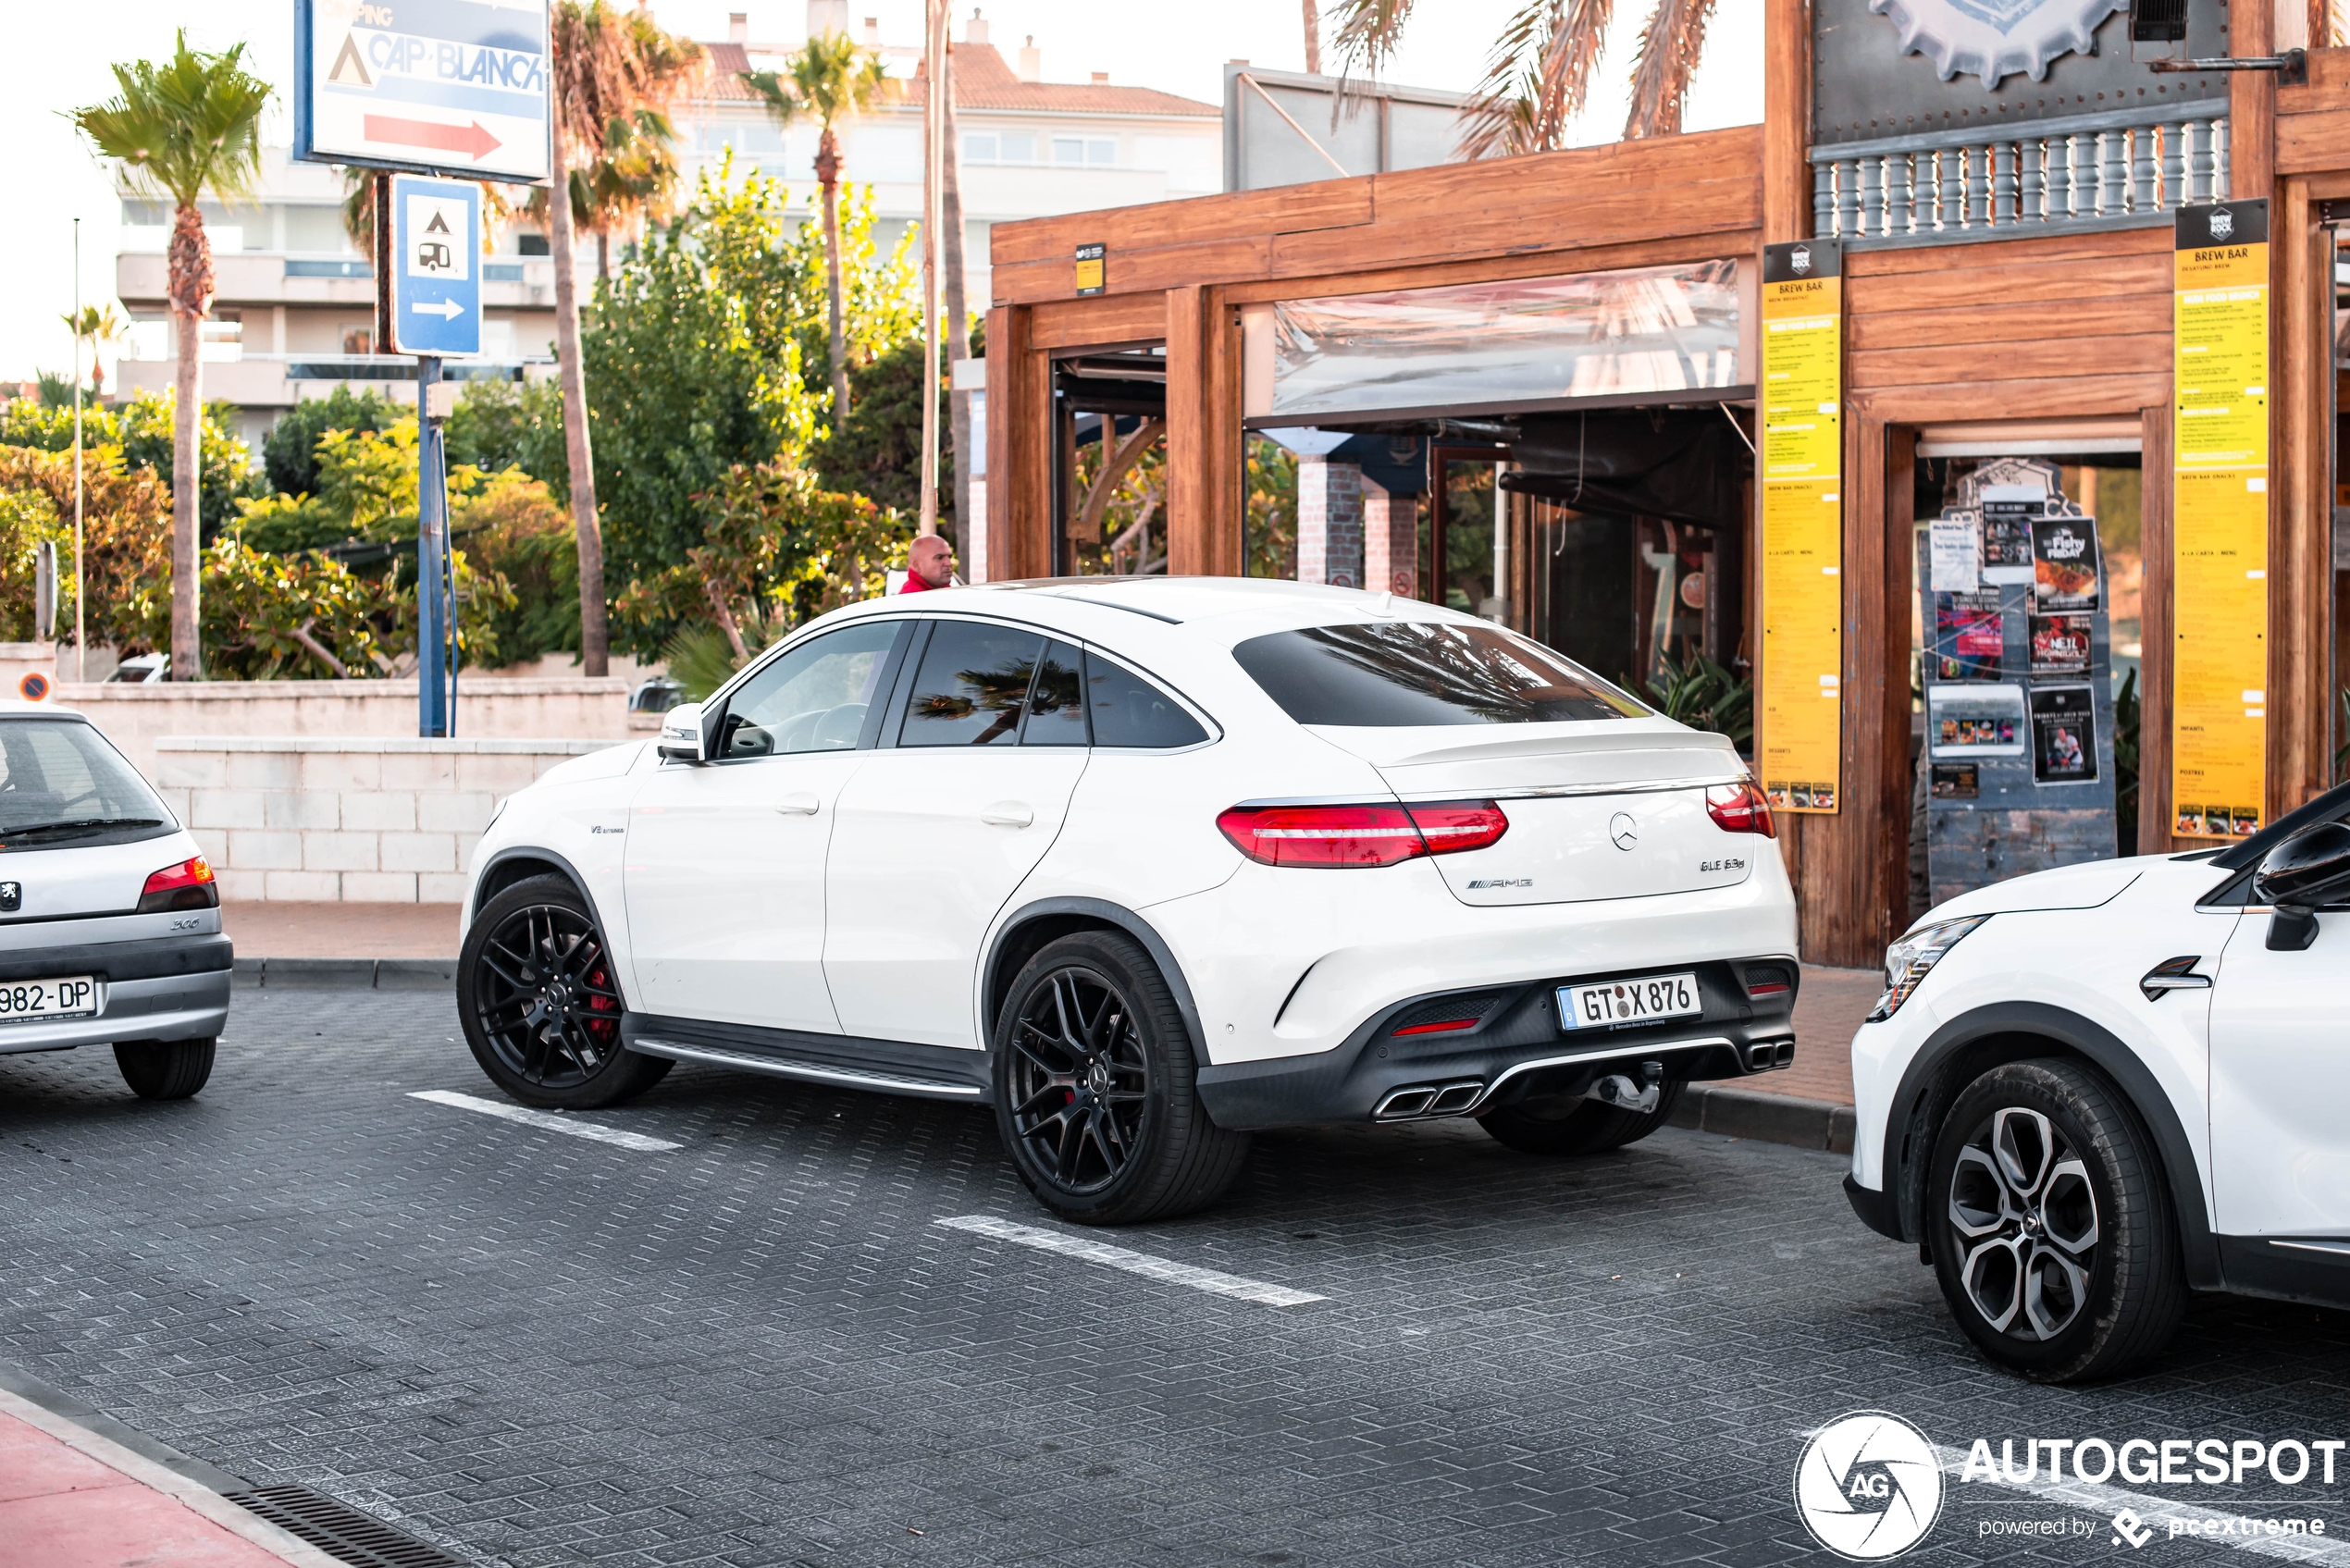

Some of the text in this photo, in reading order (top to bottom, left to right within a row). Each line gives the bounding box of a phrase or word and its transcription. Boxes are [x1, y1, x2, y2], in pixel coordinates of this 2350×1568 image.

[2195, 248, 2248, 262] BREW BAR
[1779, 281, 1824, 294] BREW BAR
[2047, 548, 2081, 560] FRIDAY
[2050, 636, 2078, 650] NEIL
[1700, 860, 1721, 871] GLE
[1490, 879, 1533, 887] AMG
[170, 917, 200, 931] 306
[1582, 988, 1613, 1021] GT
[1648, 980, 1690, 1012] 876
